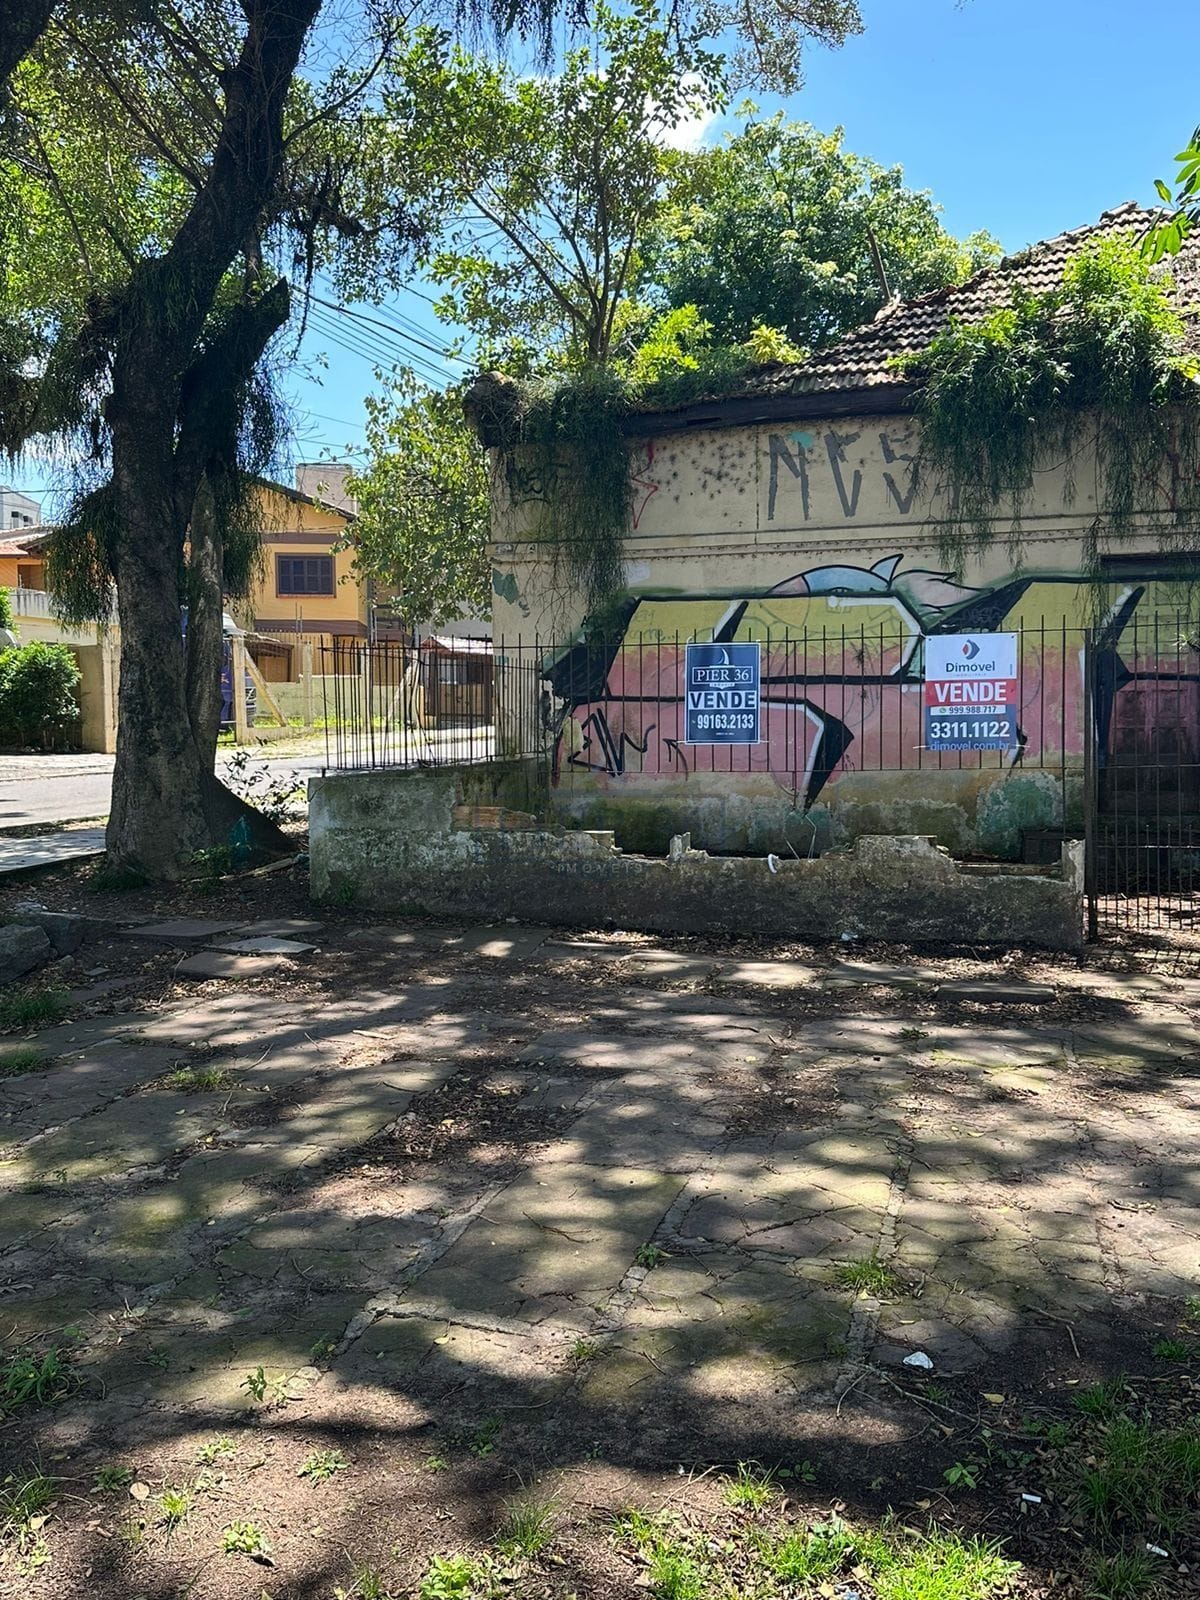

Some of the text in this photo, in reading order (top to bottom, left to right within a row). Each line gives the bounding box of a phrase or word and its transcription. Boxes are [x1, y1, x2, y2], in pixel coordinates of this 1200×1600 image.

[696, 668, 750, 682] PIER 36
[689, 691, 756, 709] VENDE
[934, 681, 1007, 703] VENDE
[697, 713, 754, 729] 99163.2133
[930, 721, 1010, 738] 3311.1122
